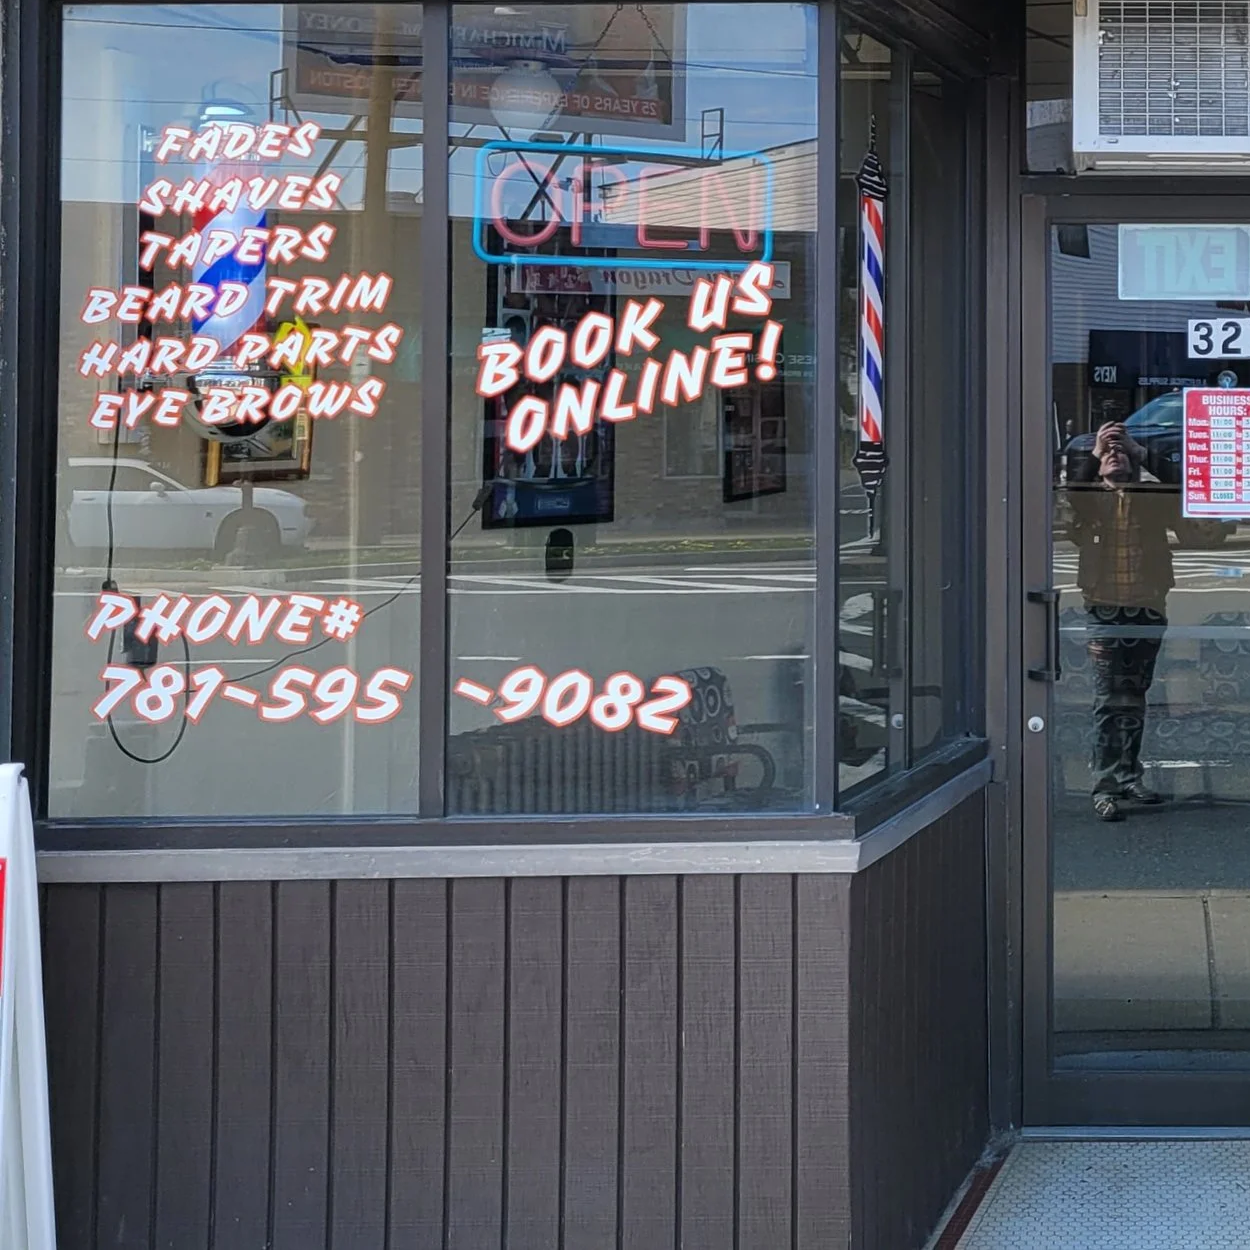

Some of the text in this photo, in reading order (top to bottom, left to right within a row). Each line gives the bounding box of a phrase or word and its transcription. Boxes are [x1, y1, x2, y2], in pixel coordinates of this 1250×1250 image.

[156, 121, 321, 164] FADES
[139, 171, 343, 214] SHAVES
[490, 161, 760, 252] OPEN
[138, 224, 334, 271] TAPERS
[81, 271, 393, 325] BEARD TRIM
[78, 326, 402, 382] HARD PARTS
[475, 261, 776, 398] BOOK US
[88, 377, 386, 429] EYE BROWS
[505, 319, 784, 453] ONLINE!
[1208, 406, 1247, 416] HOURS:
[85, 591, 365, 646] PHONE#
